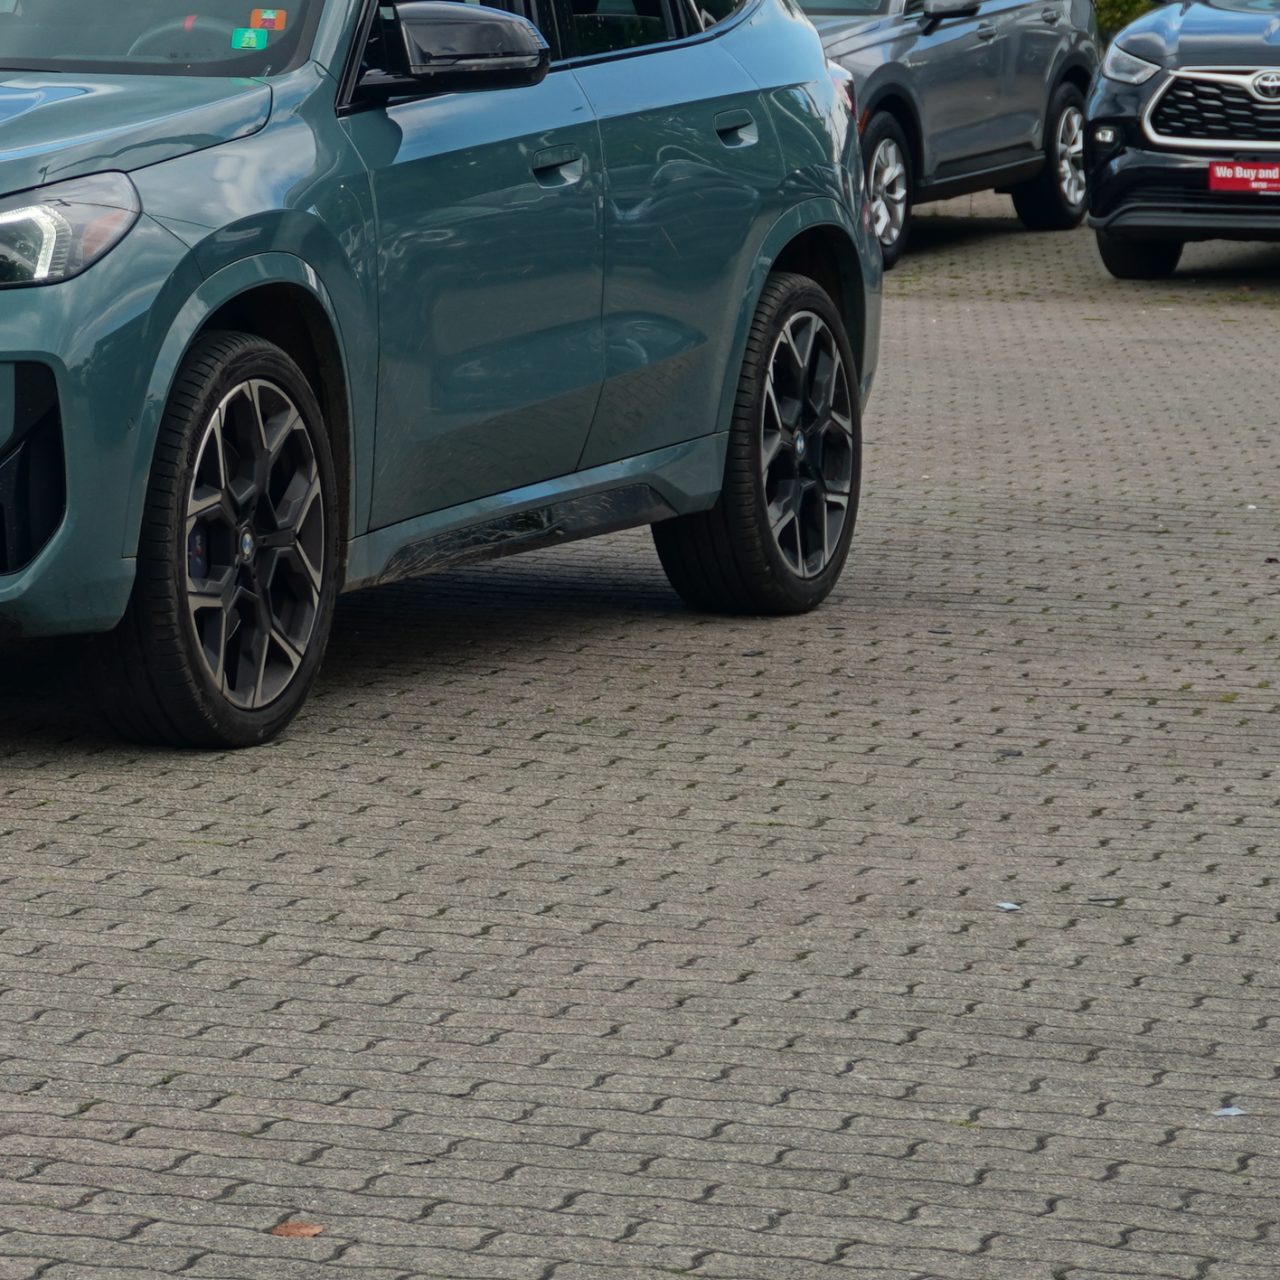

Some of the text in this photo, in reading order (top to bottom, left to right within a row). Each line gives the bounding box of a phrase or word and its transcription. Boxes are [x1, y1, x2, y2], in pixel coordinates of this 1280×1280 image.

[1215, 166, 1280, 181] We Buy and
